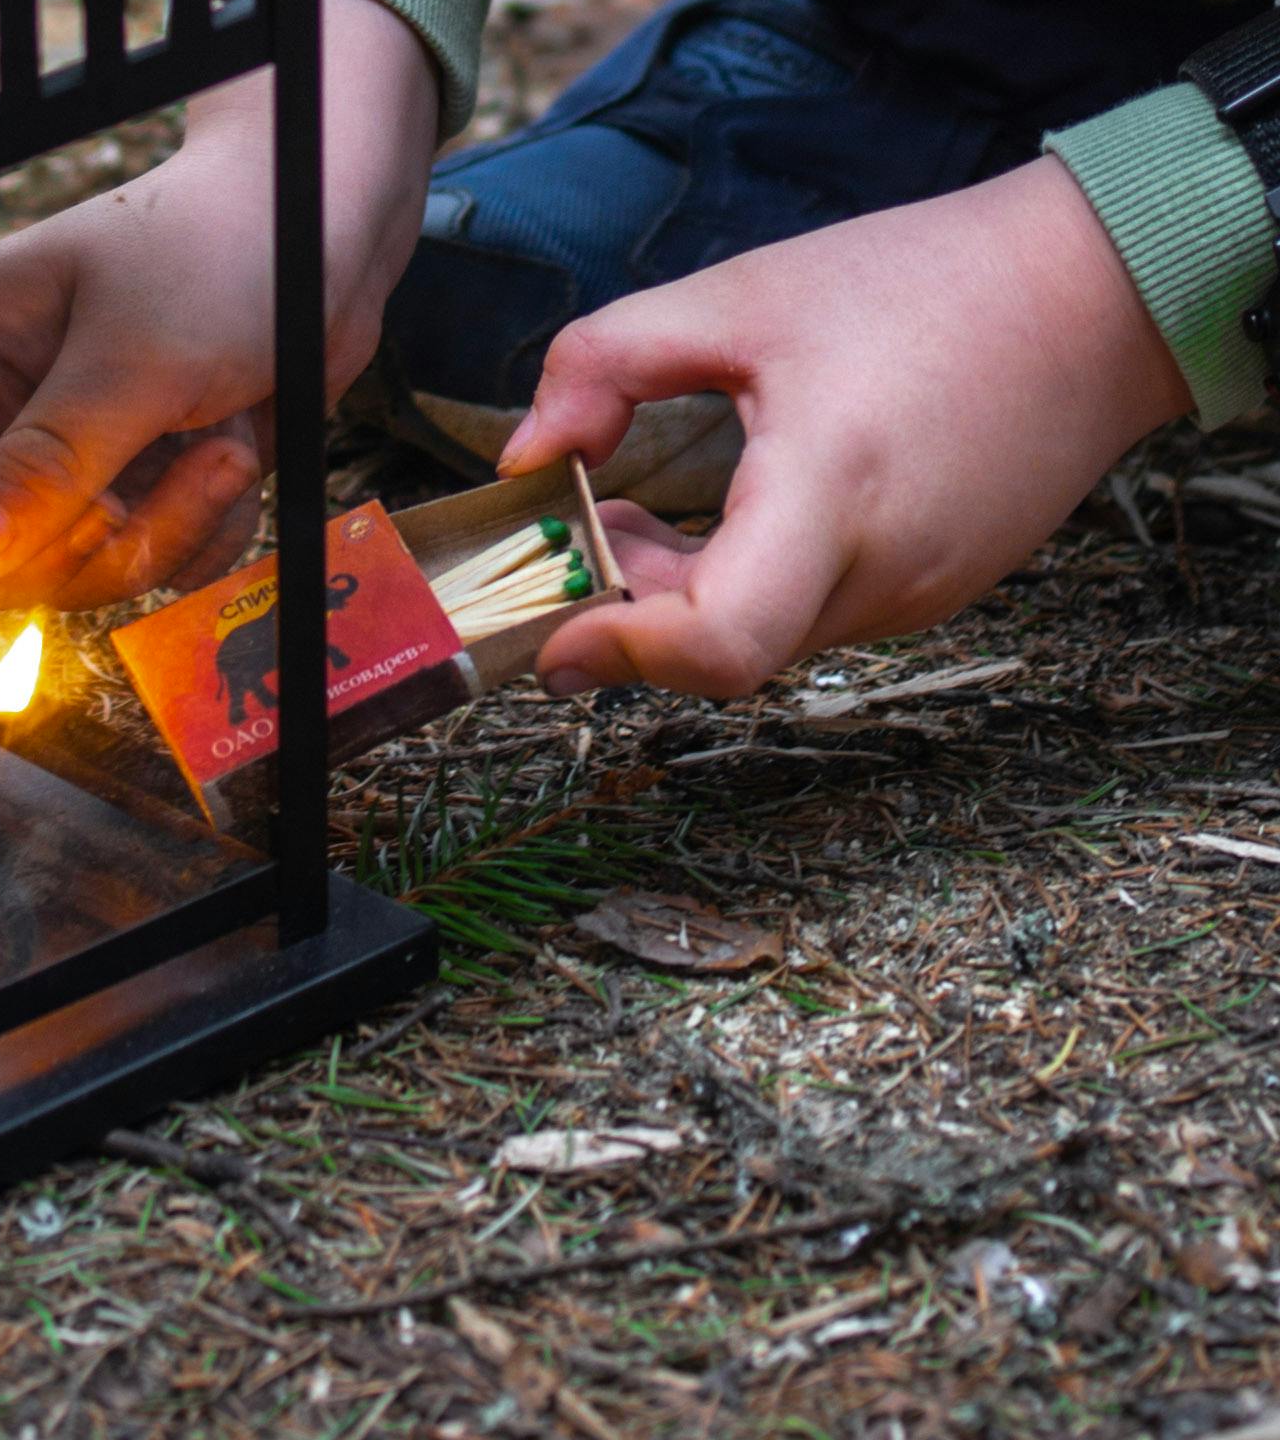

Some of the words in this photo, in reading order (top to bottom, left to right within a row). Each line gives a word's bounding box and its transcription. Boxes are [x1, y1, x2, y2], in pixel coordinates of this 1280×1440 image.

[220, 581, 277, 619] СПИЧ
[211, 719, 274, 759] ОАО
[327, 642, 429, 700] исовдрев»
